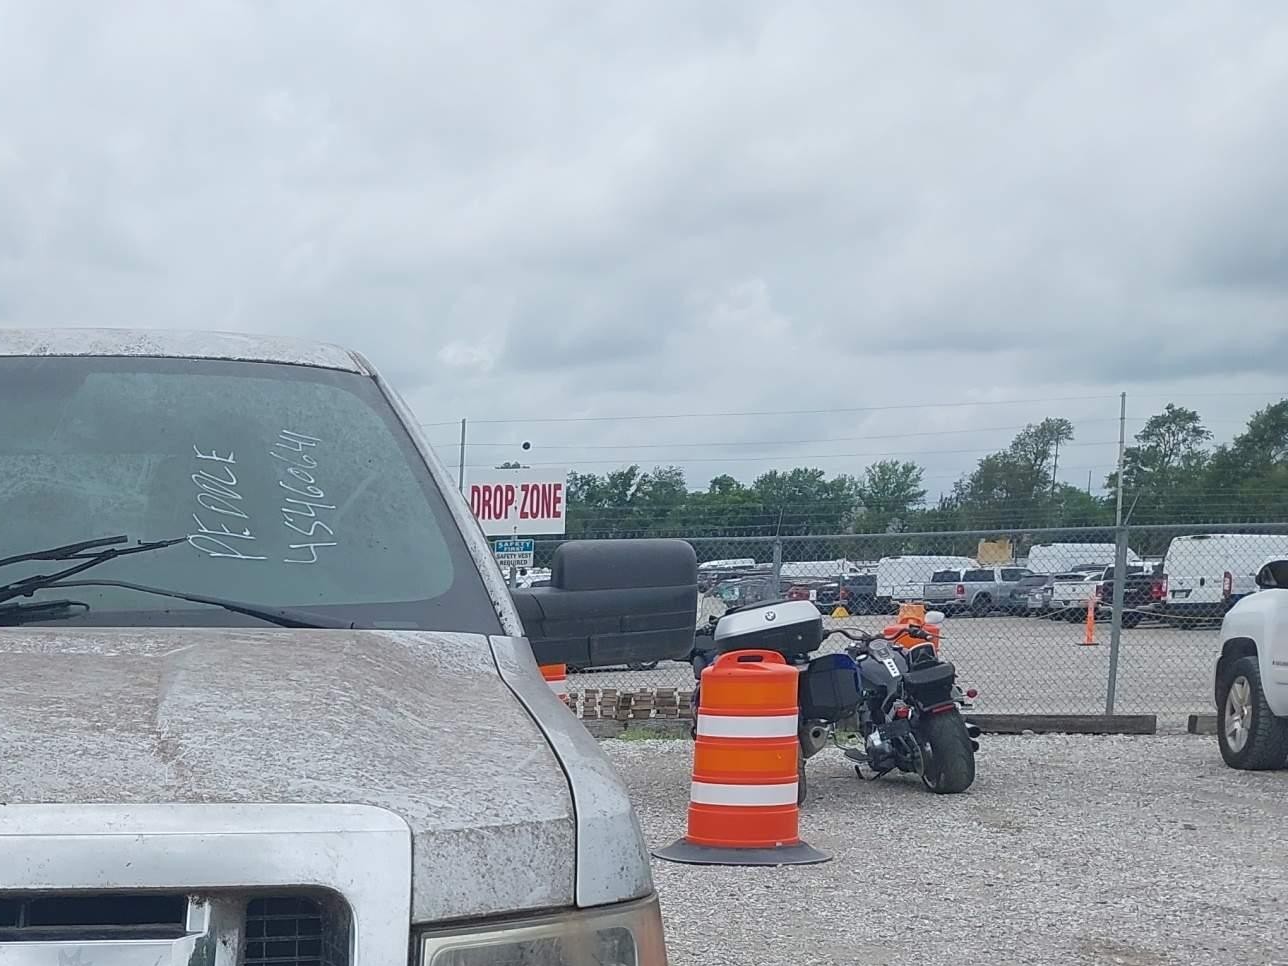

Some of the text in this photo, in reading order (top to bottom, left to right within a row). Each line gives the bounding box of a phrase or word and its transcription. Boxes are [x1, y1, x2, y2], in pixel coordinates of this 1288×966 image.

[269, 429, 338, 564] 45460641
[471, 483, 562, 520] DROP ZONE
